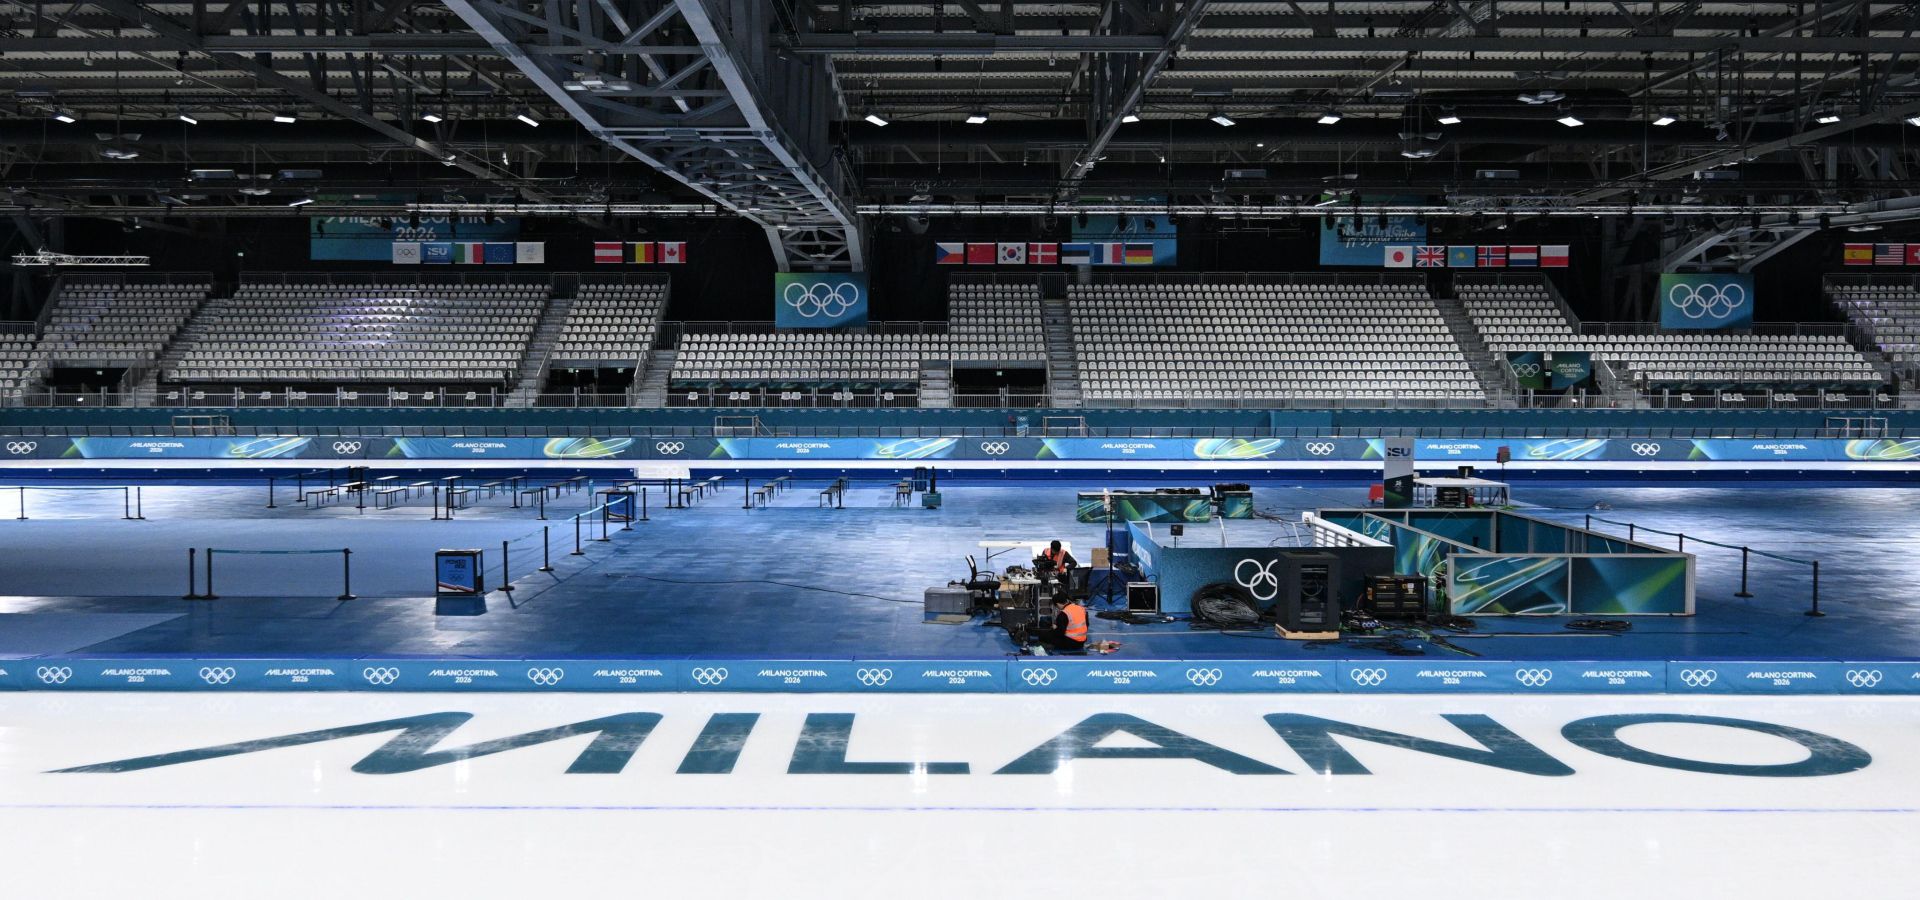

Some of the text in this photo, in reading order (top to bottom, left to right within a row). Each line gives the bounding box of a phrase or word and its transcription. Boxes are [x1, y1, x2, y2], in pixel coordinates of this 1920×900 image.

[395, 226, 437, 242] 2026
[1113, 676, 1130, 684] 2026
[1278, 676, 1295, 684] 2026
[1443, 676, 1460, 684] 2026
[1608, 676, 1625, 684] 2026
[47, 711, 1872, 777] MILANO
